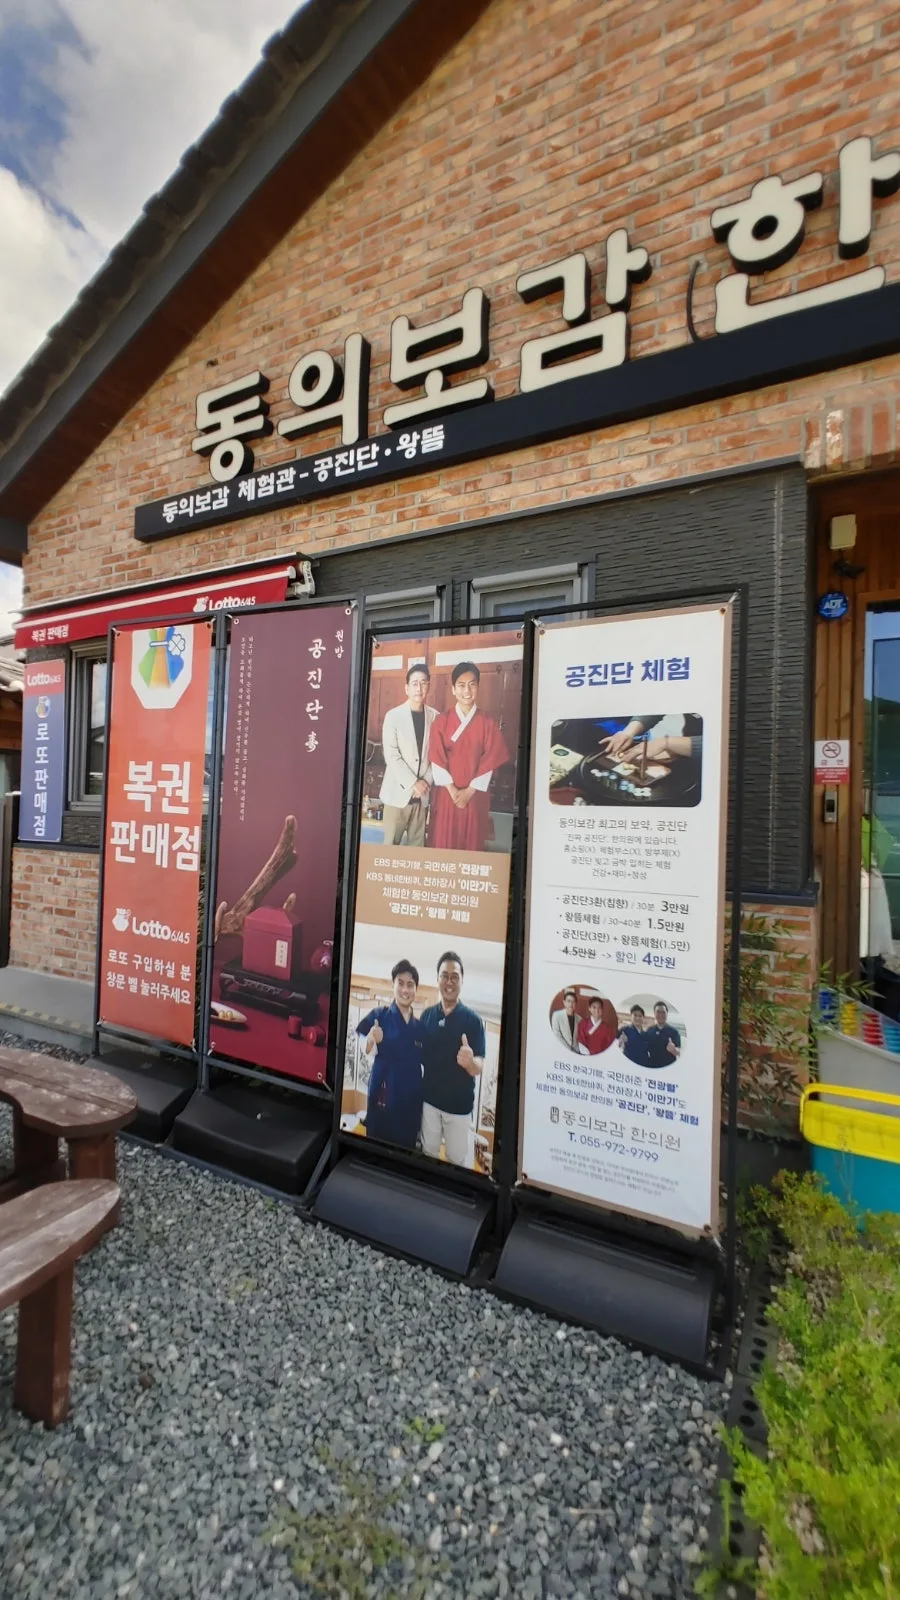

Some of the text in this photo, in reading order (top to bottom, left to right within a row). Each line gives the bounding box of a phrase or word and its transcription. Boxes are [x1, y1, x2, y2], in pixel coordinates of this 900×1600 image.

[191, 136, 900, 483] 동의보감 한
[162, 485, 230, 524] 동의보감
[238, 467, 296, 502] 체험관
[313, 443, 380, 483] 공진단
[396, 424, 446, 460] 왕뜸
[31, 624, 69, 642] 복권 판매점
[565, 656, 690, 688] 공진단 체험
[123, 760, 191, 814] 복권
[559, 817, 596, 829] 동의보감
[598, 819, 627, 830] 최고의
[656, 820, 688, 832] 공진단
[110, 820, 200, 871] 판매점
[373, 857, 391, 867] EBS
[423, 861, 457, 874] 국민허준
[571, 856, 592, 865] 공진단
[366, 872, 383, 881] KBS
[382, 887, 479, 908] 체험한 동의보감 한의원
[661, 900, 690, 915] 3만원
[451, 911, 470, 923] 체험
[565, 912, 600, 924] 왕뜸체험
[647, 918, 685, 933] 1.5만원
[562, 928, 610, 943] 공진단(3만)
[621, 934, 690, 951] 왕뜸체험(1.5만)
[108, 949, 191, 982] 로또 구입하실 분
[562, 945, 596, 959] 4.5만원
[615, 951, 637, 965] 할인
[642, 952, 676, 969] 4만원
[106, 971, 191, 1004] 창문 벨 눌러주세요
[554, 1060, 571, 1072] EBS
[607, 1070, 642, 1087] 국민허준
[546, 1072, 564, 1083] KBS
[606, 1084, 643, 1100] 천하장사
[562, 1110, 626, 1139] 동의보감
[631, 1126, 681, 1152] 한의원
[679, 1112, 700, 1126] 체험
[568, 1131, 660, 1162] T. 055-972-9799
